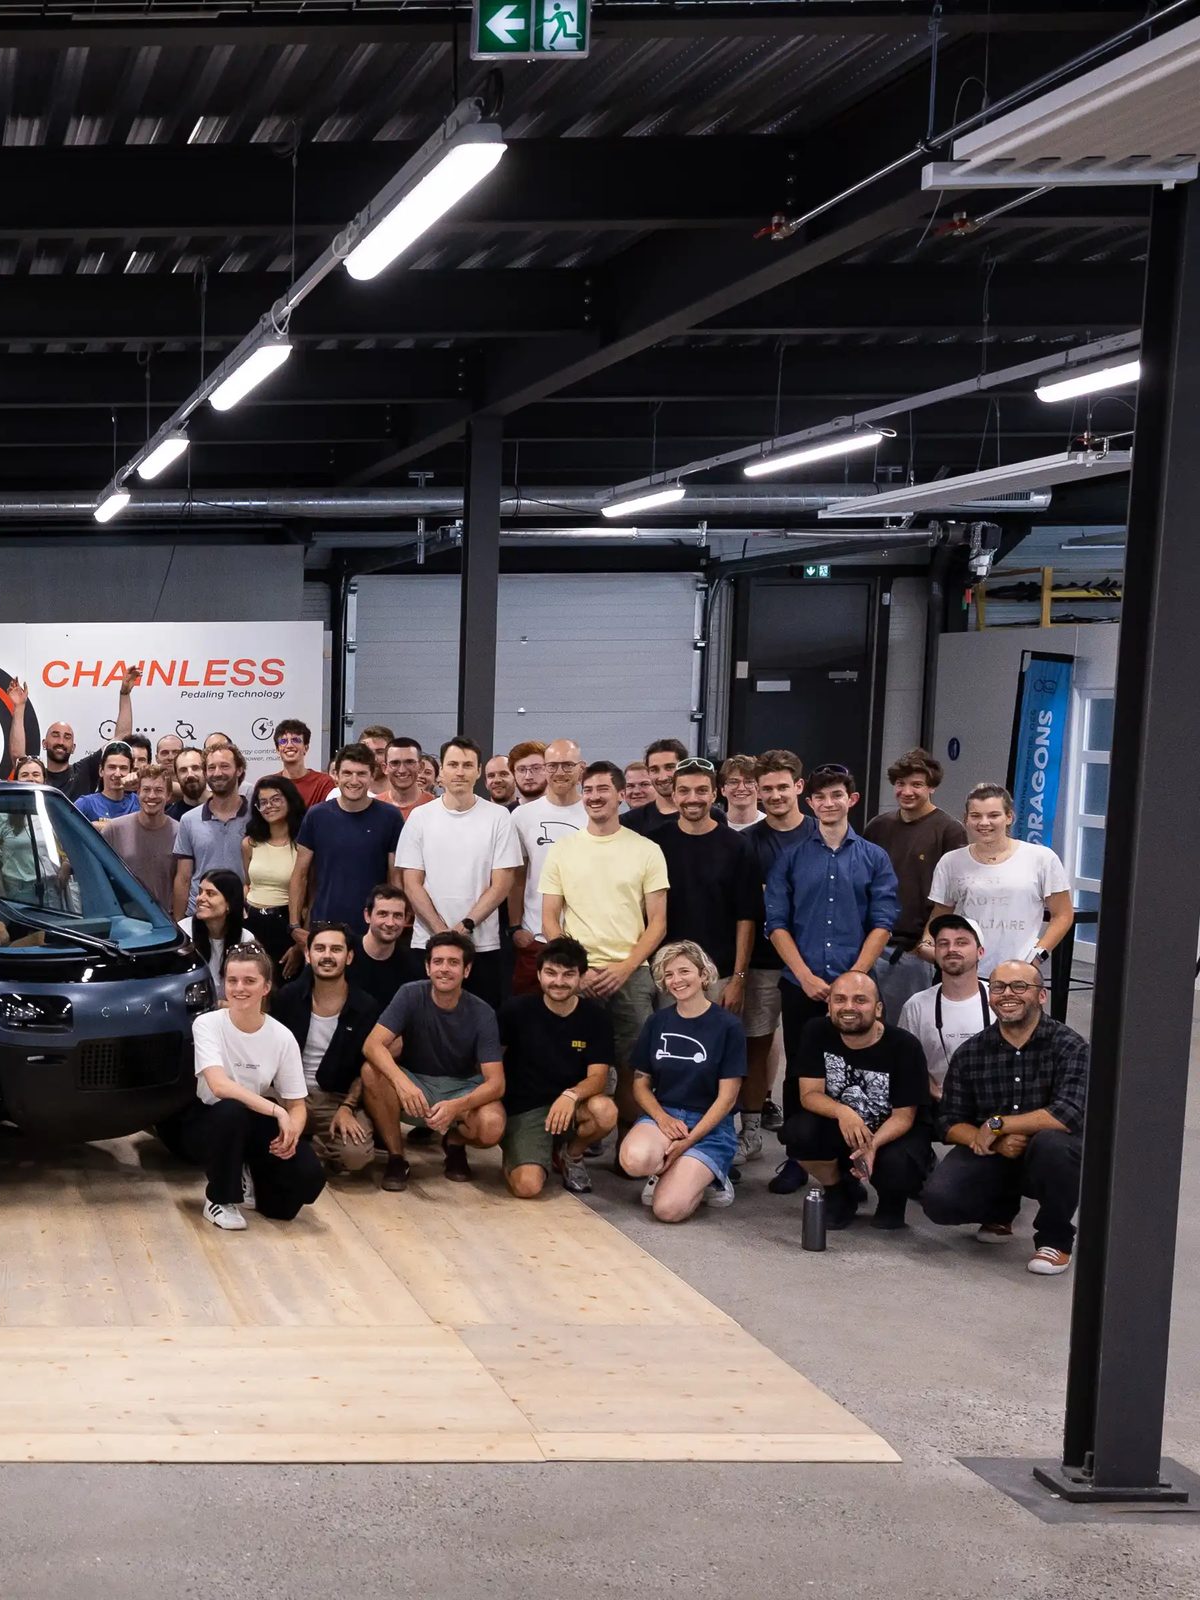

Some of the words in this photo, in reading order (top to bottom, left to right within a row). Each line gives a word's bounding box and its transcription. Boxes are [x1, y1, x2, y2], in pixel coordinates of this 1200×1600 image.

[42, 658, 286, 688] CHAINLESS
[180, 690, 224, 699] Pedaling
[226, 689, 285, 699] Technology
